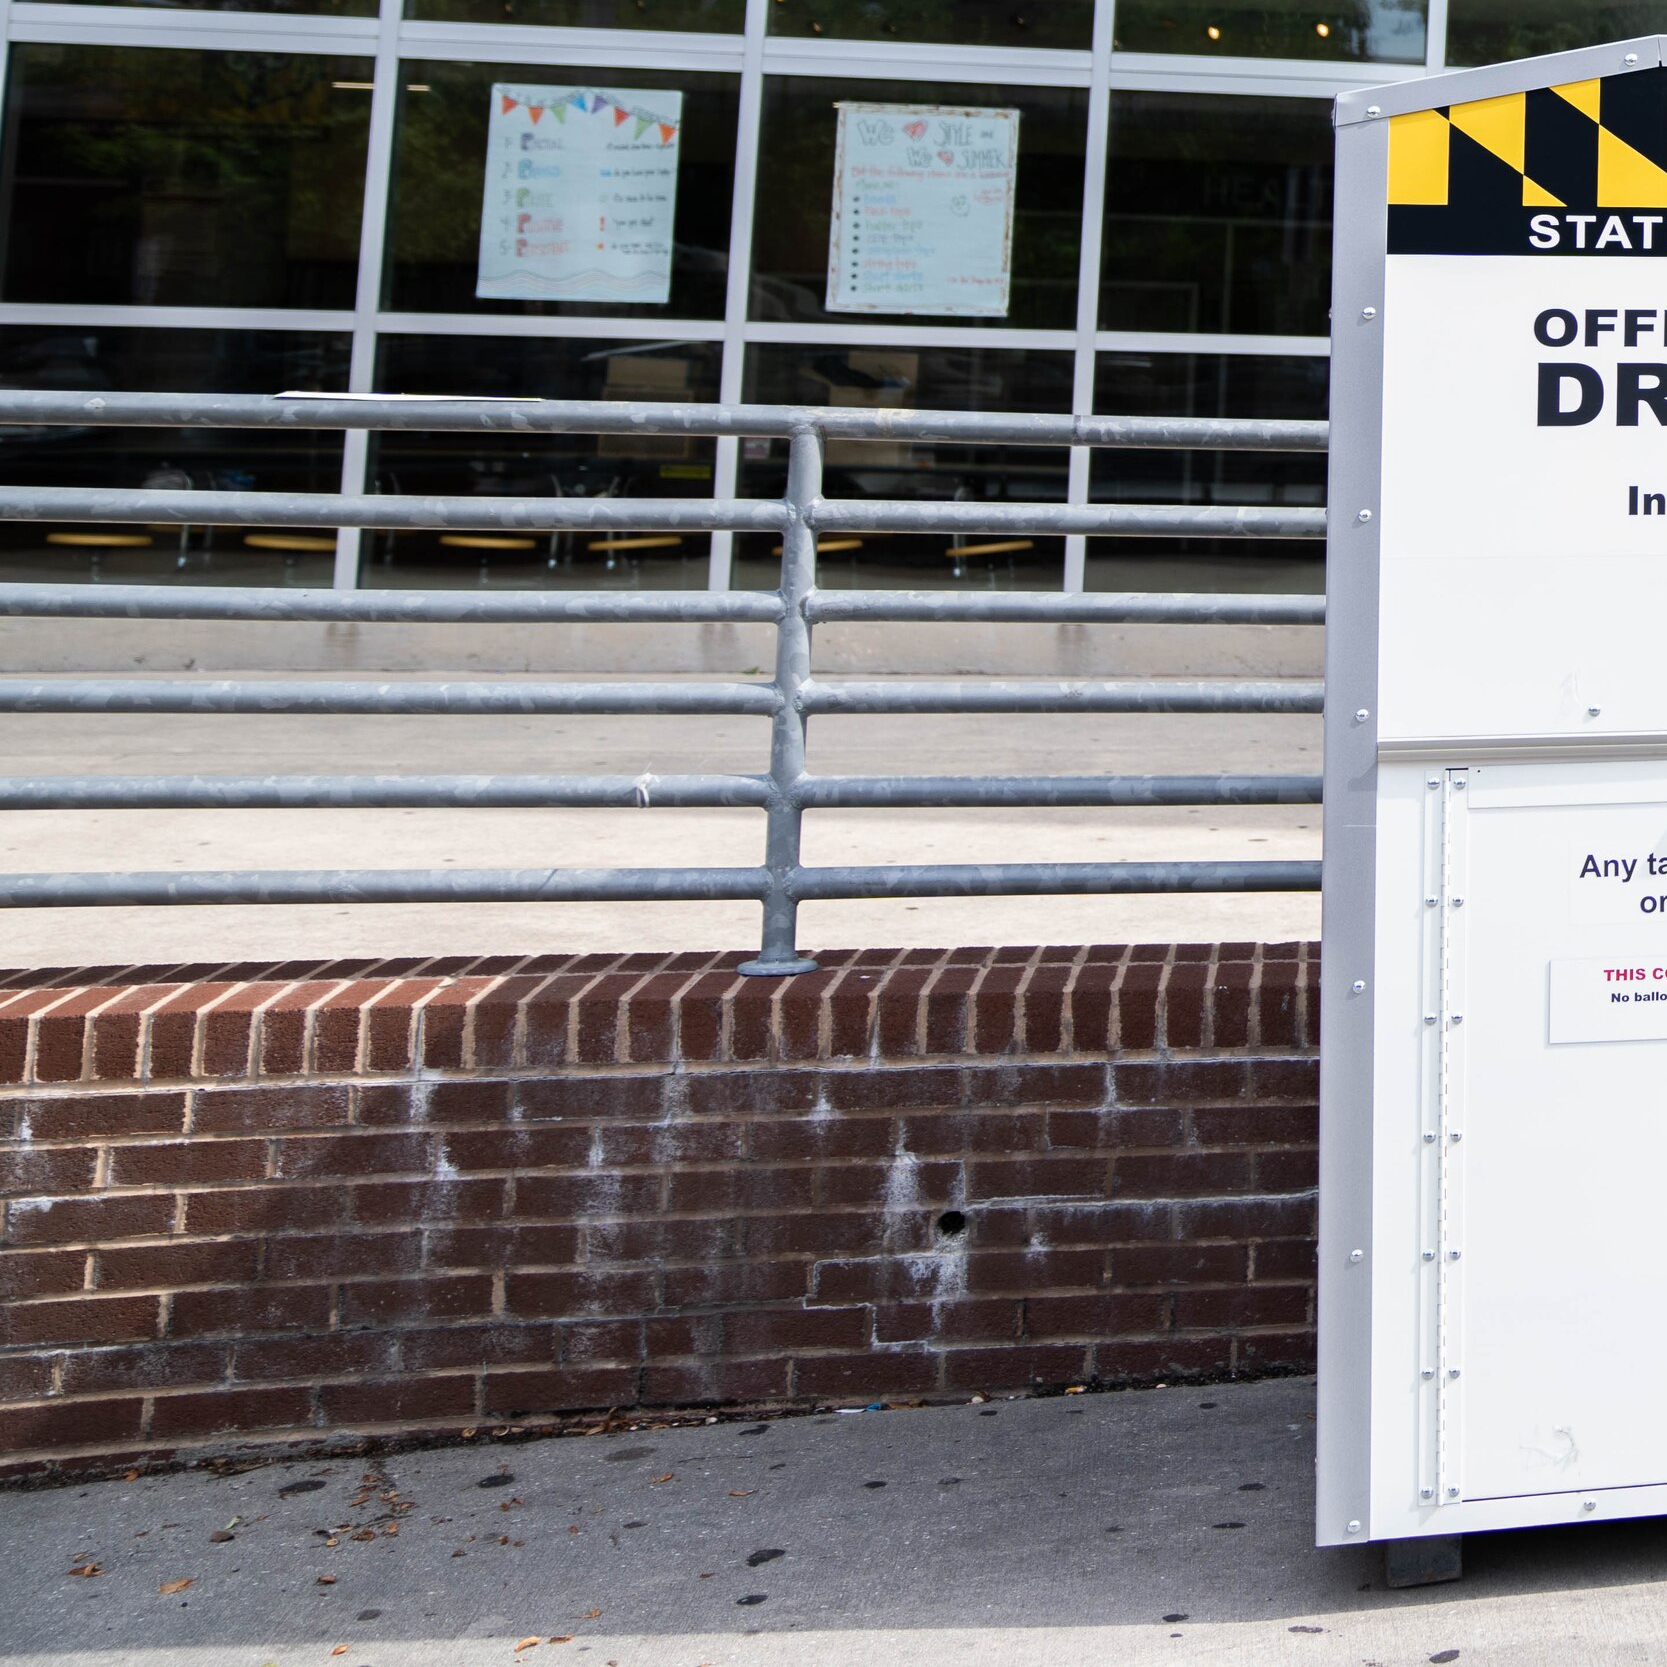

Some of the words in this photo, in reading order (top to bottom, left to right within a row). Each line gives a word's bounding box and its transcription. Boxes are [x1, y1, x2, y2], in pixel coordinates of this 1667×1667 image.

[1580, 855, 1637, 882] Any
[1604, 969, 1645, 981] THIS
[1612, 993, 1629, 1002] No
